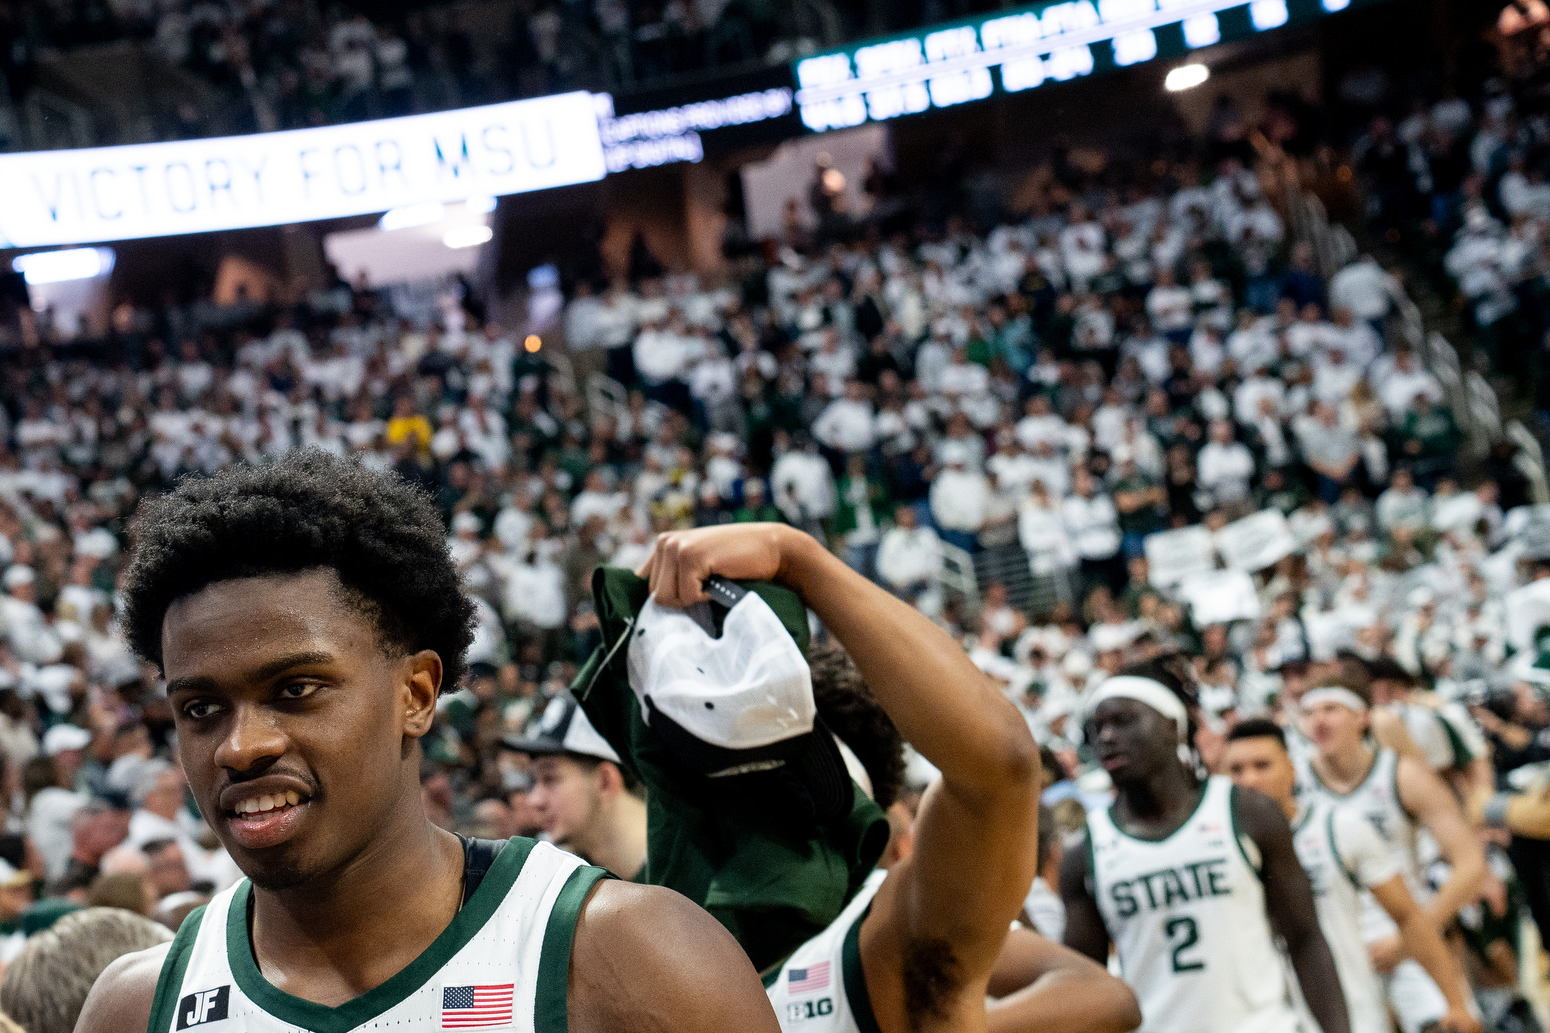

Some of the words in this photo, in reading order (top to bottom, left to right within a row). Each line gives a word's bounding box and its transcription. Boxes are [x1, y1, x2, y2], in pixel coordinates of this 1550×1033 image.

[29, 153, 269, 222] VICTORY
[298, 139, 408, 199] FOR
[430, 115, 558, 183] MSU
[1109, 857, 1233, 918] STATE
[1164, 915, 1205, 973] 2
[186, 988, 220, 1027] JF
